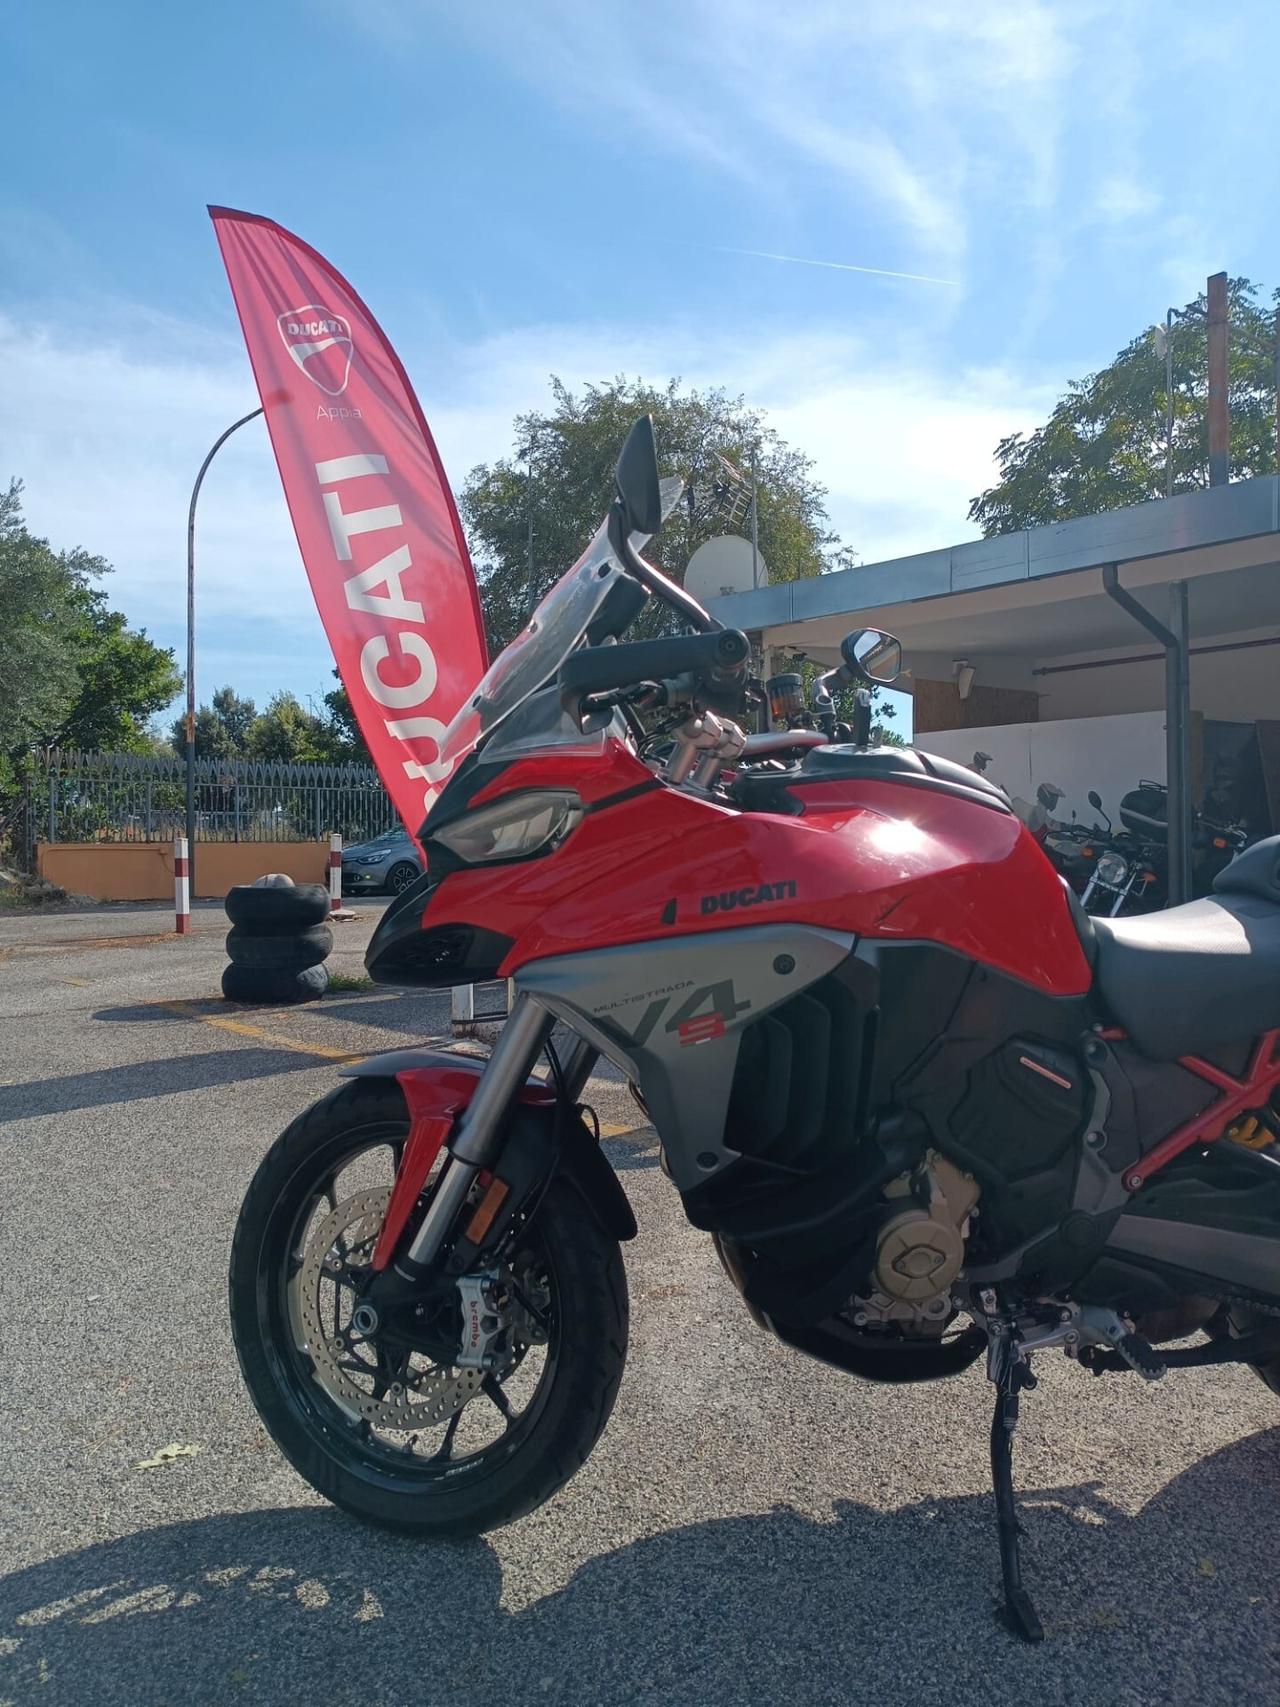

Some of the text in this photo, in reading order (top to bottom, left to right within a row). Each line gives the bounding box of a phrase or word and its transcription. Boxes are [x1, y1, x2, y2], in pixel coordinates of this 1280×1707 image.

[288, 319, 343, 336] DUCATI
[316, 405, 362, 420] Appia
[315, 453, 455, 814] UCATI
[701, 880, 797, 915] DUCATI
[593, 980, 696, 1014] MULTISTRADA
[469, 1301, 482, 1348] brembo
